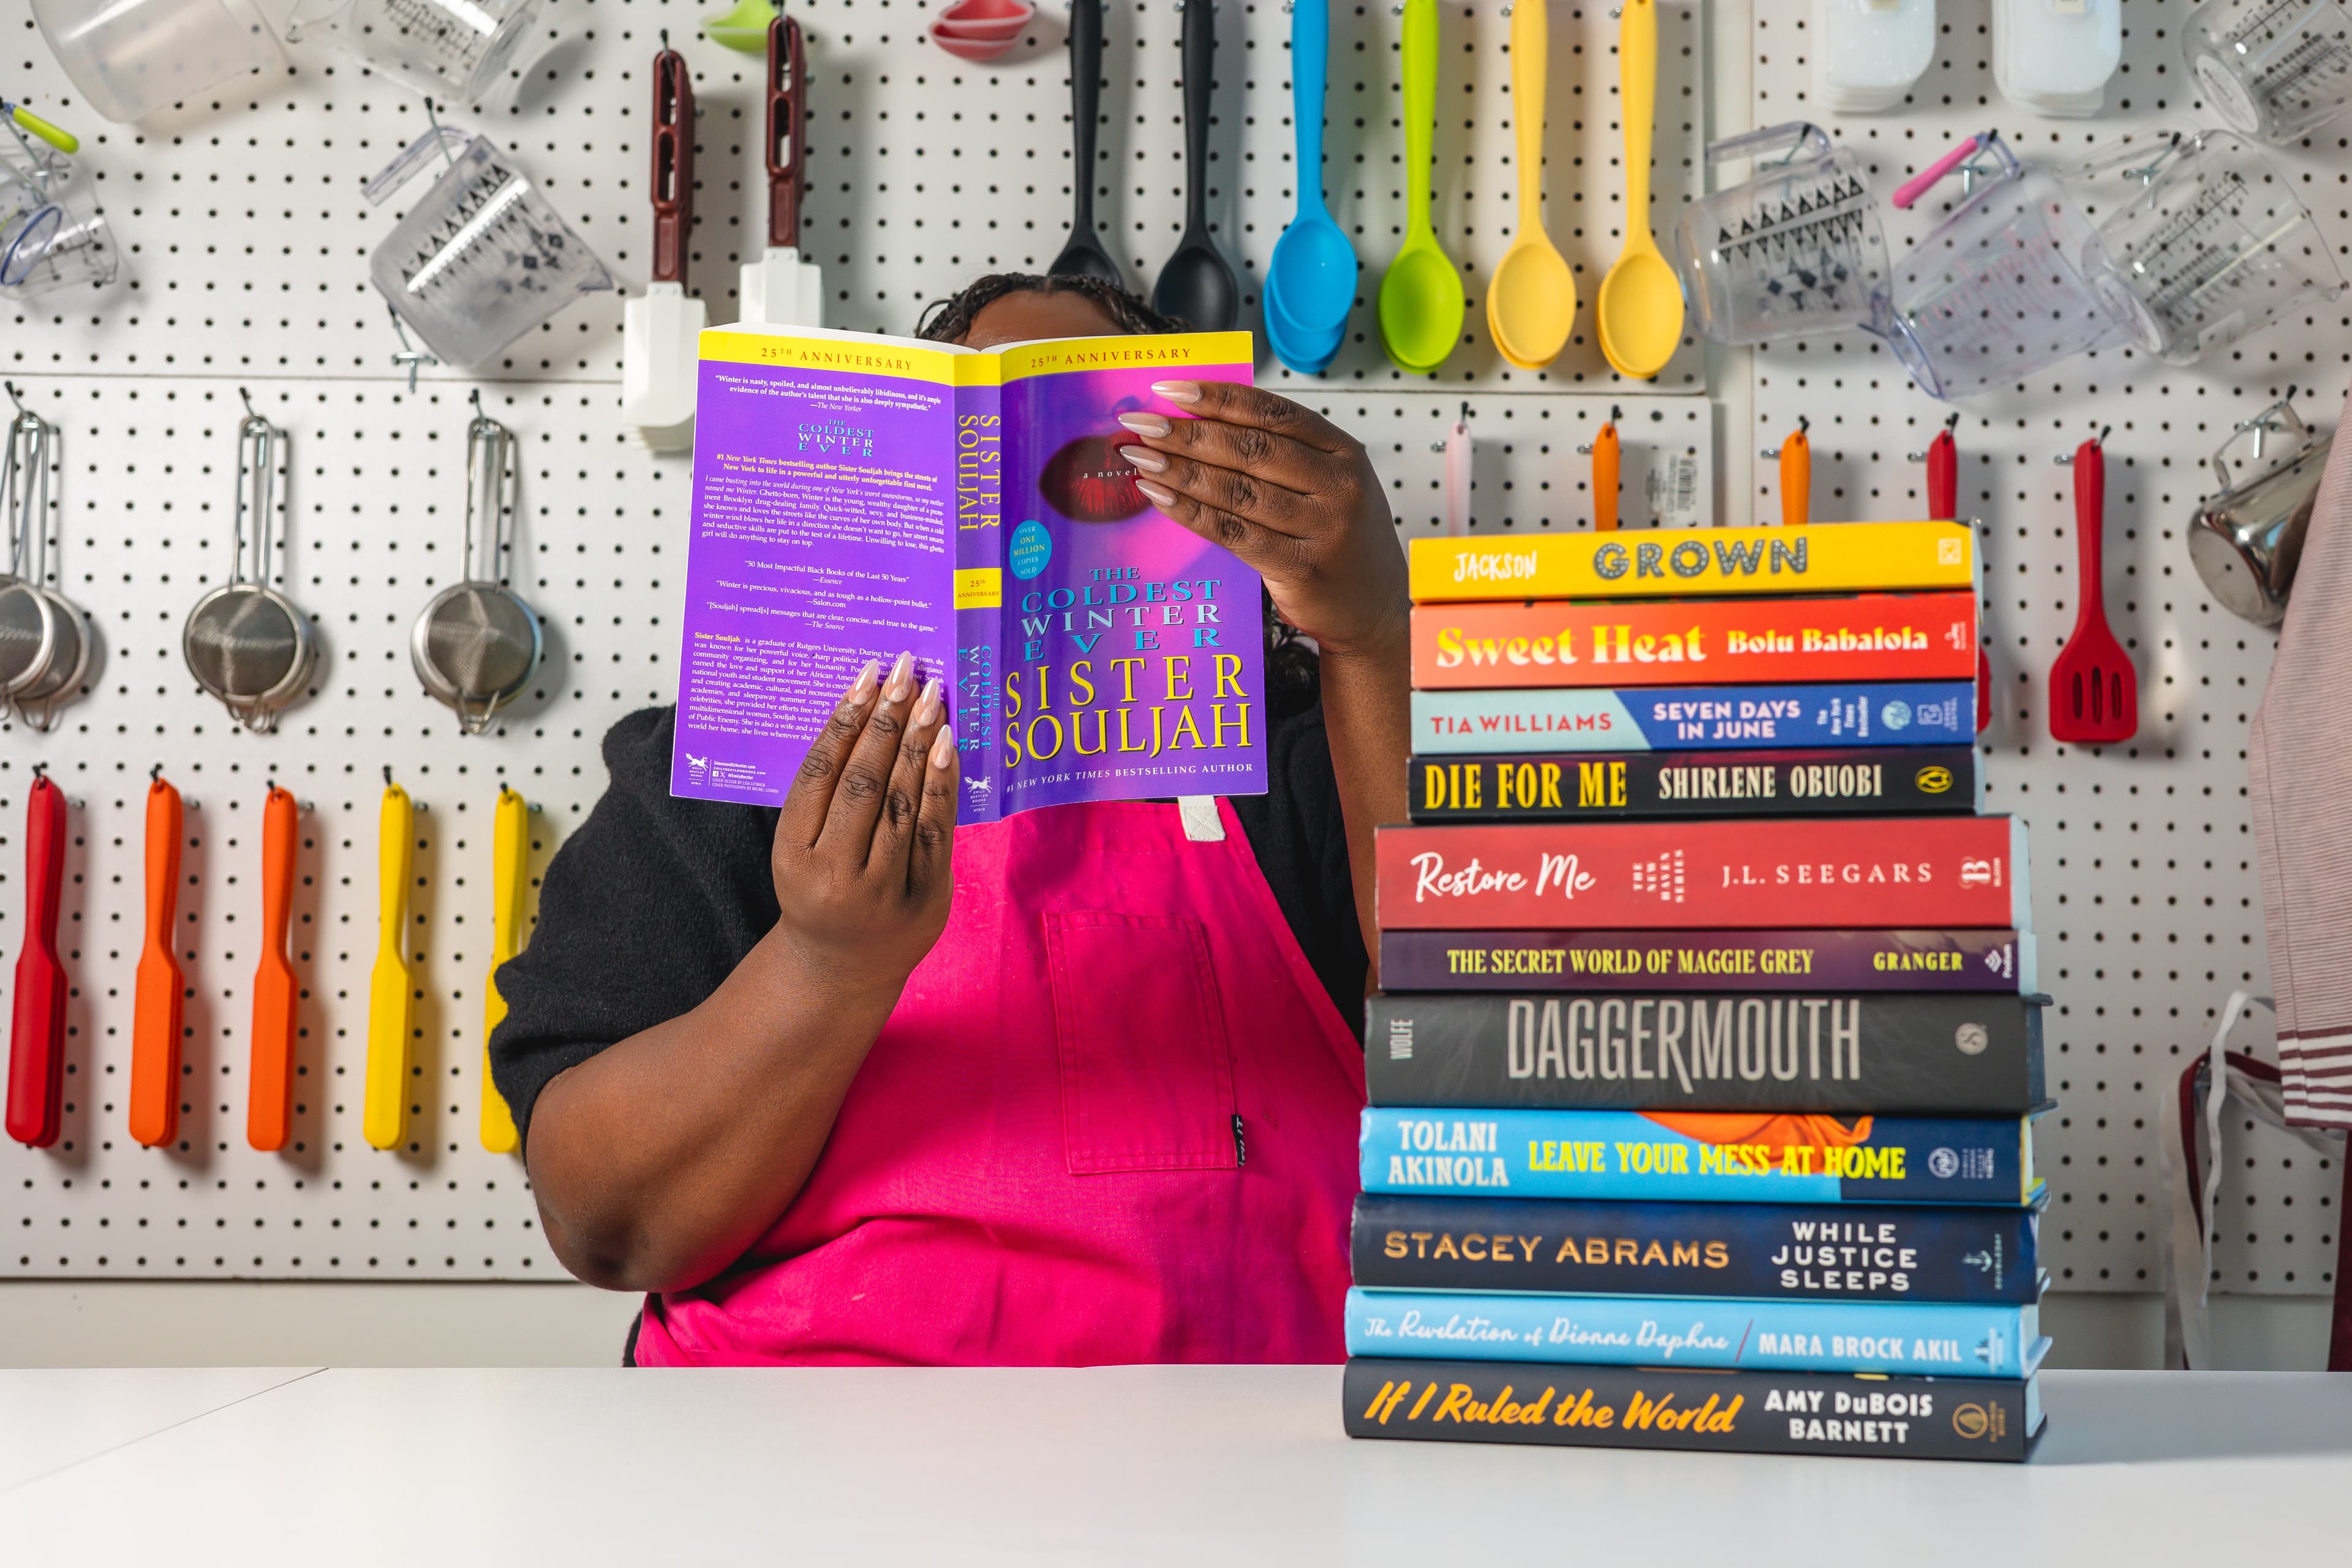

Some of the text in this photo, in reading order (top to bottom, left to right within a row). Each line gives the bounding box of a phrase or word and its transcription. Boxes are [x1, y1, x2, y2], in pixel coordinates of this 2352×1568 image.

[800, 351, 911, 370] ANNIVERSARY
[1065, 348, 1189, 364] ANNIVERSARY
[833, 385, 873, 396] unbelievably
[875, 388, 907, 399] libidinous,
[873, 398, 894, 407] deeply
[798, 433, 873, 447] WINTER
[799, 423, 873, 439] COLDEST
[798, 442, 872, 458] EVER
[778, 459, 814, 470] bestselling
[858, 466, 882, 475] Souljah
[884, 469, 903, 478] brings
[959, 415, 978, 529] SOULJAH
[980, 415, 1000, 528] SISTER
[1098, 467, 1136, 477] novel
[1014, 543, 1044, 556] MILLION
[1020, 535, 1035, 544] ONE
[775, 563, 805, 572] Impactful
[1017, 556, 1038, 565] COPIES
[1453, 551, 1537, 582] JACKSON
[1593, 536, 1807, 580] GROWN
[1089, 567, 1140, 581] THE
[1022, 580, 1220, 612] COLDEST
[1021, 604, 1221, 636] WINTER
[1024, 628, 1221, 661] EVER
[1436, 625, 1706, 667] Sweet Heat
[1728, 630, 1793, 654] Bolu
[1803, 627, 1928, 652] Babalola
[970, 645, 979, 751] WINTER
[980, 645, 991, 750] COLDEST
[1006, 654, 1247, 718] SISTER
[957, 649, 968, 754] EVER
[1654, 700, 1800, 720] SEVEN DAYS
[1006, 703, 1251, 767] SOULJAH
[1430, 713, 1611, 734] TIA WILLIAMS
[1678, 720, 1774, 739] IN JUNE
[1017, 778, 1036, 789] NEW
[1041, 773, 1070, 783] YORK
[1076, 769, 1109, 779] TIMES
[1115, 765, 1196, 776] BESTSELLING
[1201, 763, 1253, 772] AUTHOR
[1425, 761, 1626, 809] DIE FOR ME
[1659, 764, 1881, 799] SHIRLENE OBUOBI
[1410, 851, 1596, 902] Restore Me
[1722, 863, 1931, 888] J.L. SEEGARS
[1447, 949, 1813, 973] THE SECRET WORLD OF MAGGIE GREY
[1873, 952, 1962, 970] GRANGER
[2002, 944, 2011, 978] Podium
[1390, 1019, 1412, 1059] WOLFE
[1508, 999, 1859, 1093] DAGGERMOUTH
[1398, 1120, 1496, 1151] TOLANI
[1388, 1155, 1508, 1185] AKINOLA
[1529, 1142, 1905, 1179] LEAVE YOUR MESS AT HOME
[1792, 1221, 1896, 1243] WHILE
[1384, 1231, 1728, 1268] STACEY ABRAMS
[1771, 1245, 1917, 1268] JUSTICE
[1781, 1268, 1909, 1291] SLEEPS
[1364, 1310, 1730, 1359] The Revelation of Dionne Daphne
[1758, 1332, 1961, 1362] MARA BROCK AKIL
[1364, 1381, 1744, 1433] If I Ruled the World
[1764, 1389, 1932, 1416] AMY DuBOIS
[1789, 1418, 1909, 1442] BARNETT
